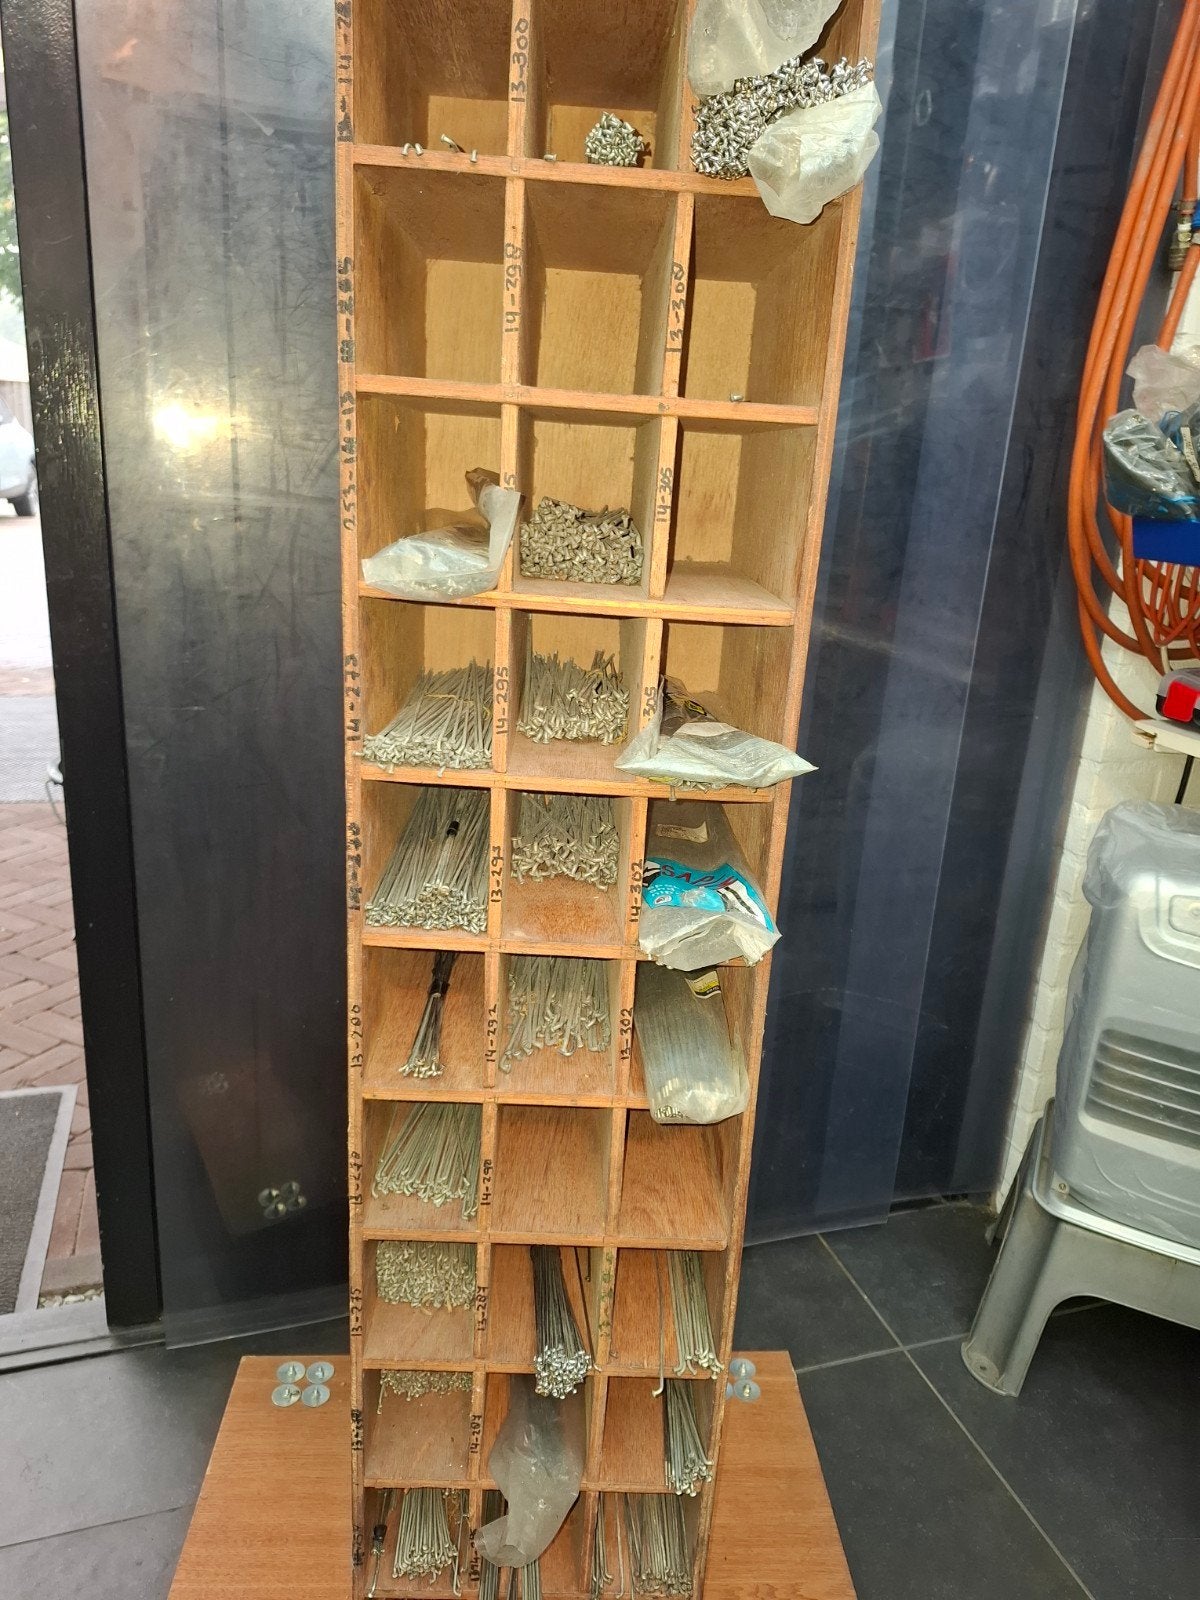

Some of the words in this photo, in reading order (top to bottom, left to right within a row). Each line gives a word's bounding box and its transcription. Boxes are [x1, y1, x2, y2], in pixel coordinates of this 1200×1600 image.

[495, 666, 509, 735] 14-295
[628, 858, 643, 923] 14-302
[485, 1004, 498, 1063] 14-292
[619, 1007, 634, 1061] 13-302
[350, 1286, 363, 1337] 13-275
